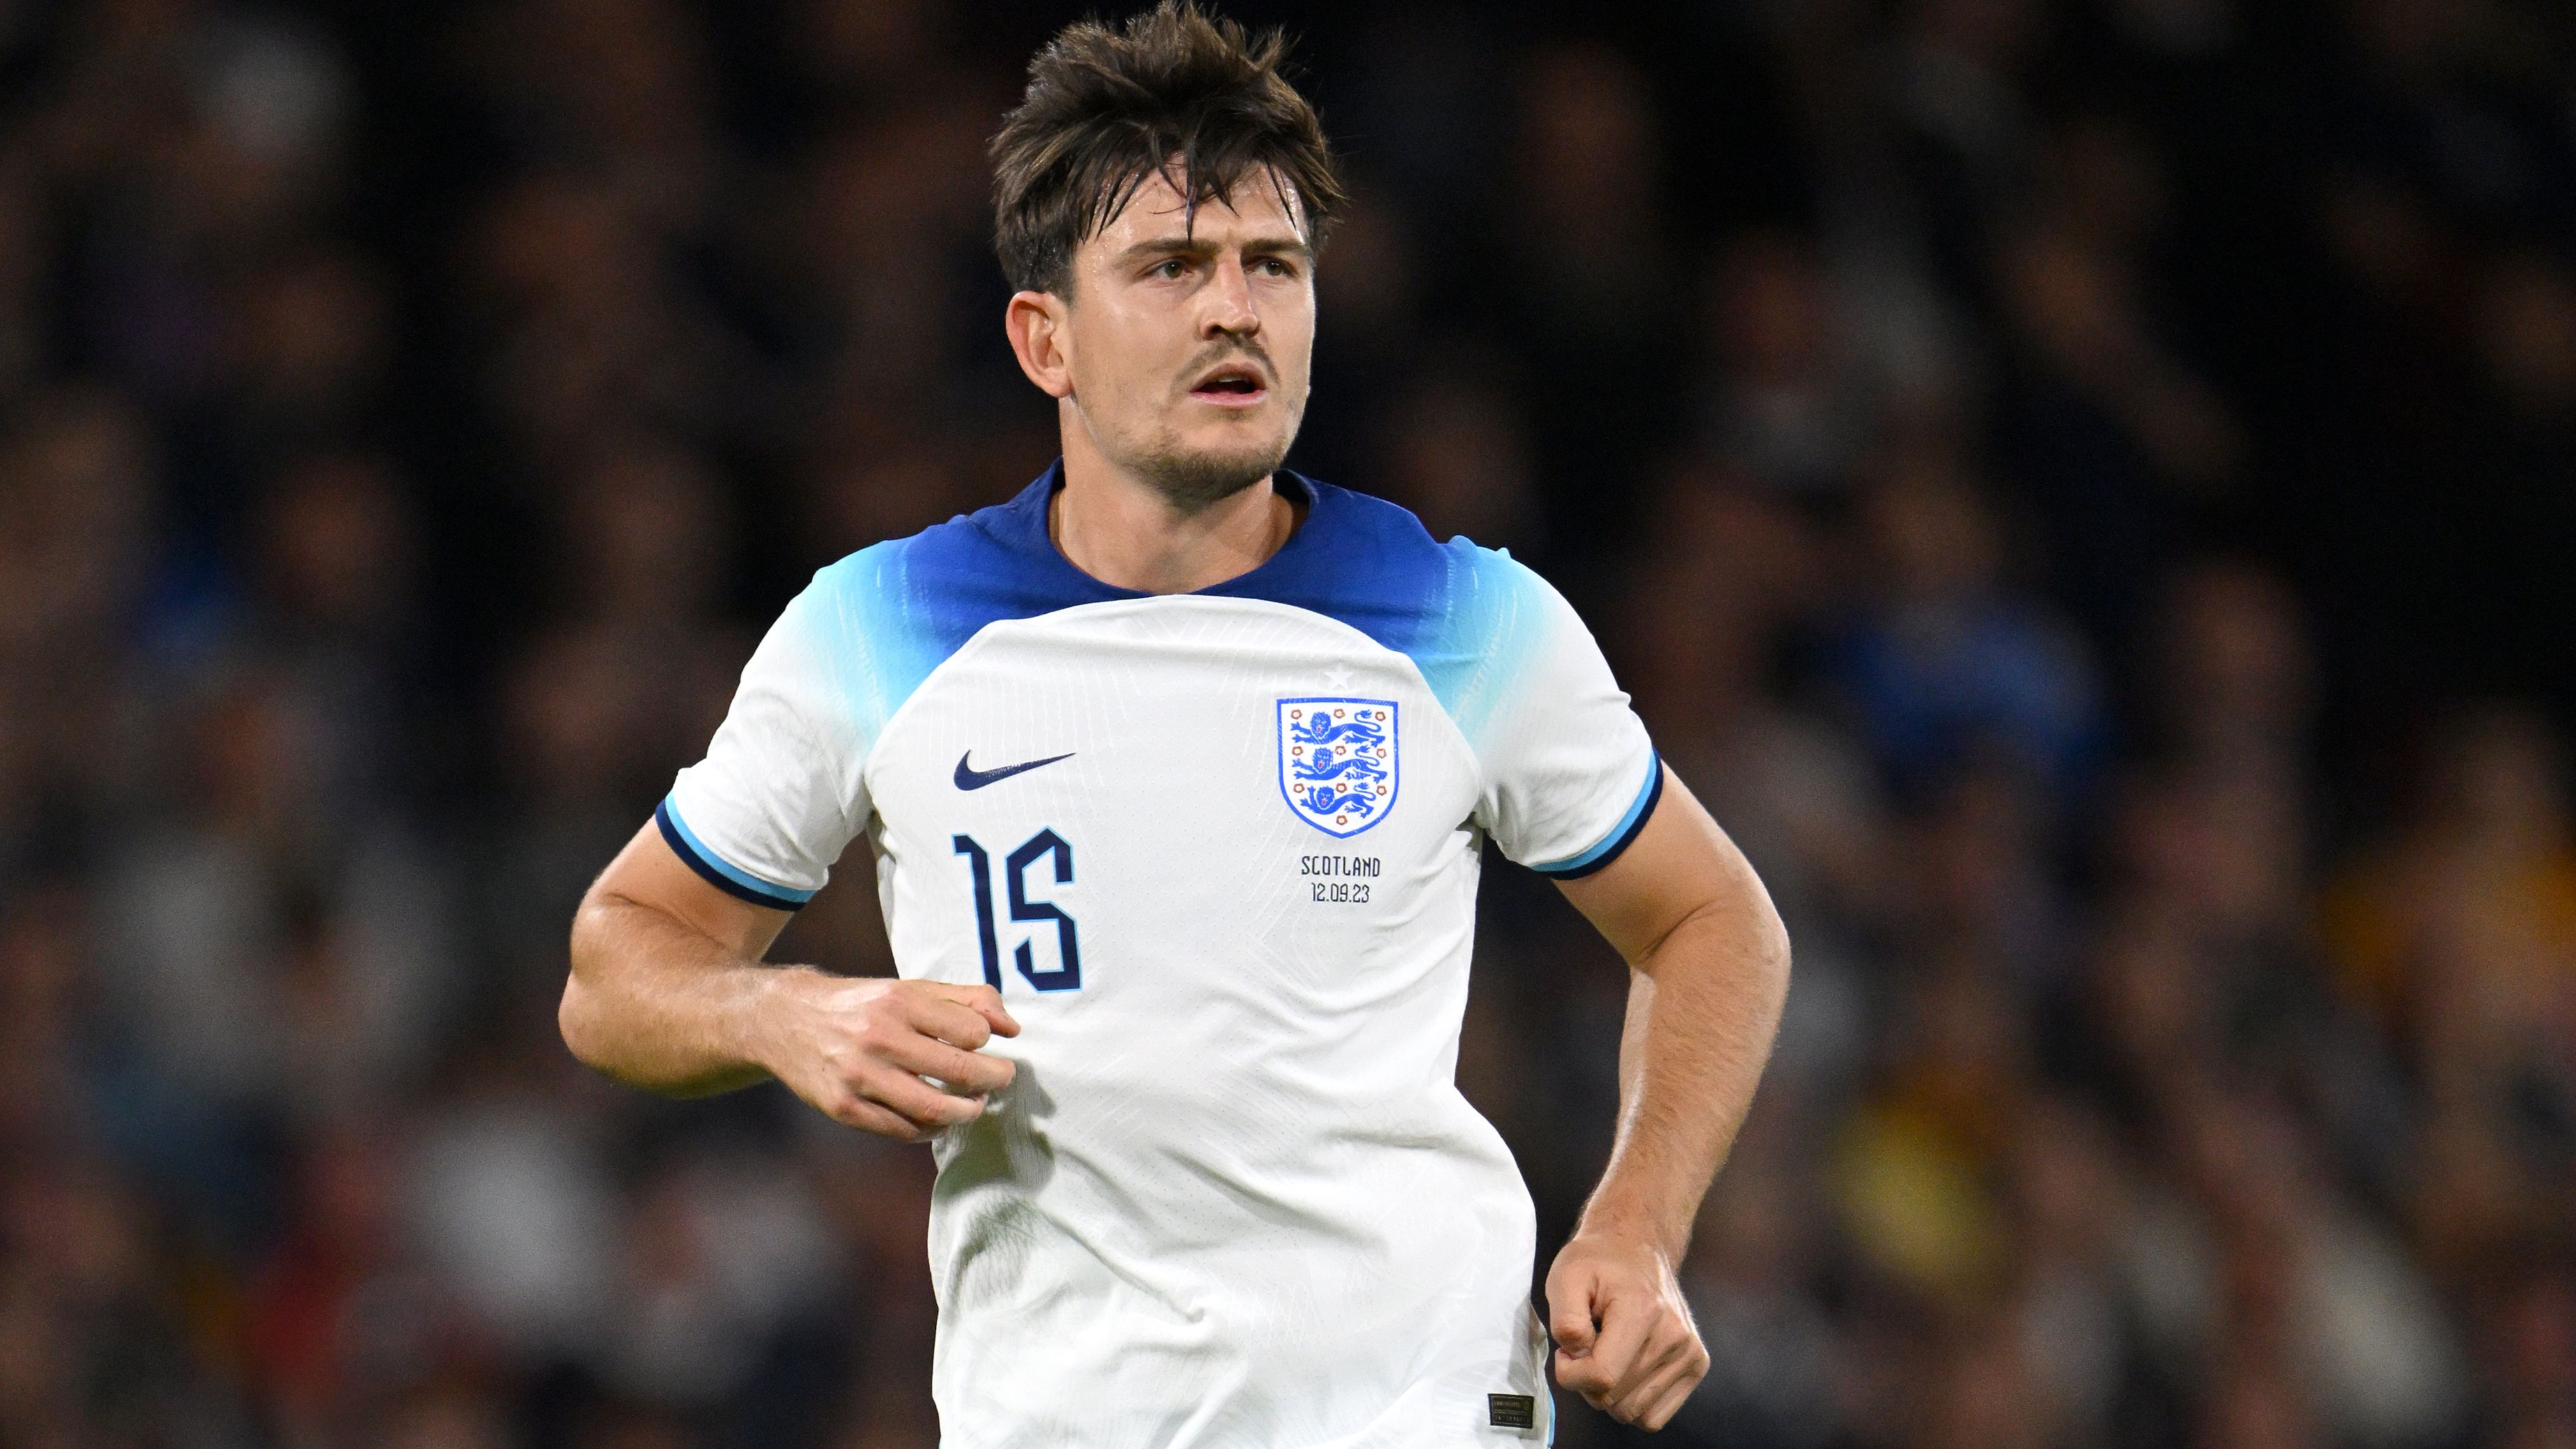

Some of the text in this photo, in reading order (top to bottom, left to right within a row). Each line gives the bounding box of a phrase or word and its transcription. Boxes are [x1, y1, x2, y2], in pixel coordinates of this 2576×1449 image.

[1301, 856, 1380, 877] SCOTLAND
[1311, 882, 1370, 903] 12.09.23
[952, 825, 1083, 994] 15
